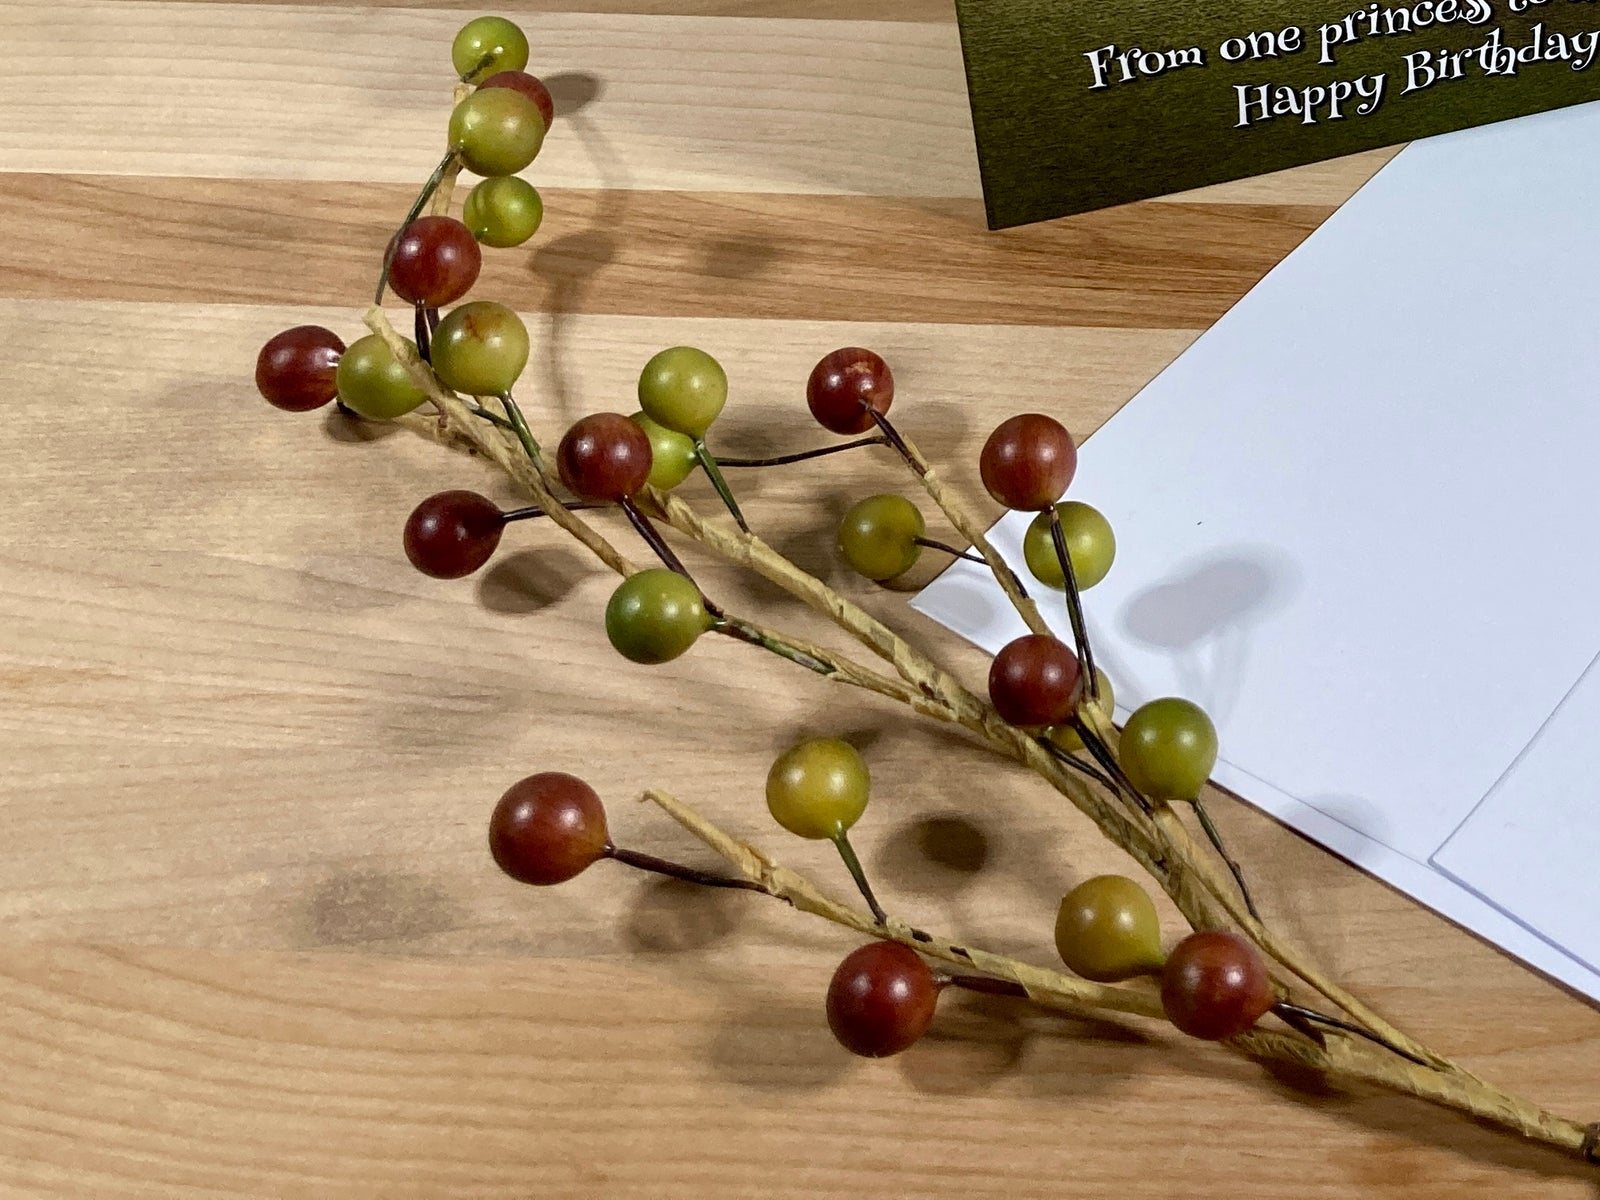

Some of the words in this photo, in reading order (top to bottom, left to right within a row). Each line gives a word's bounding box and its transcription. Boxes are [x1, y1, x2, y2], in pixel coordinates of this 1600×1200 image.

[1083, 45, 1202, 88] From
[1219, 24, 1301, 62] one
[1231, 74, 1383, 128] Happy
